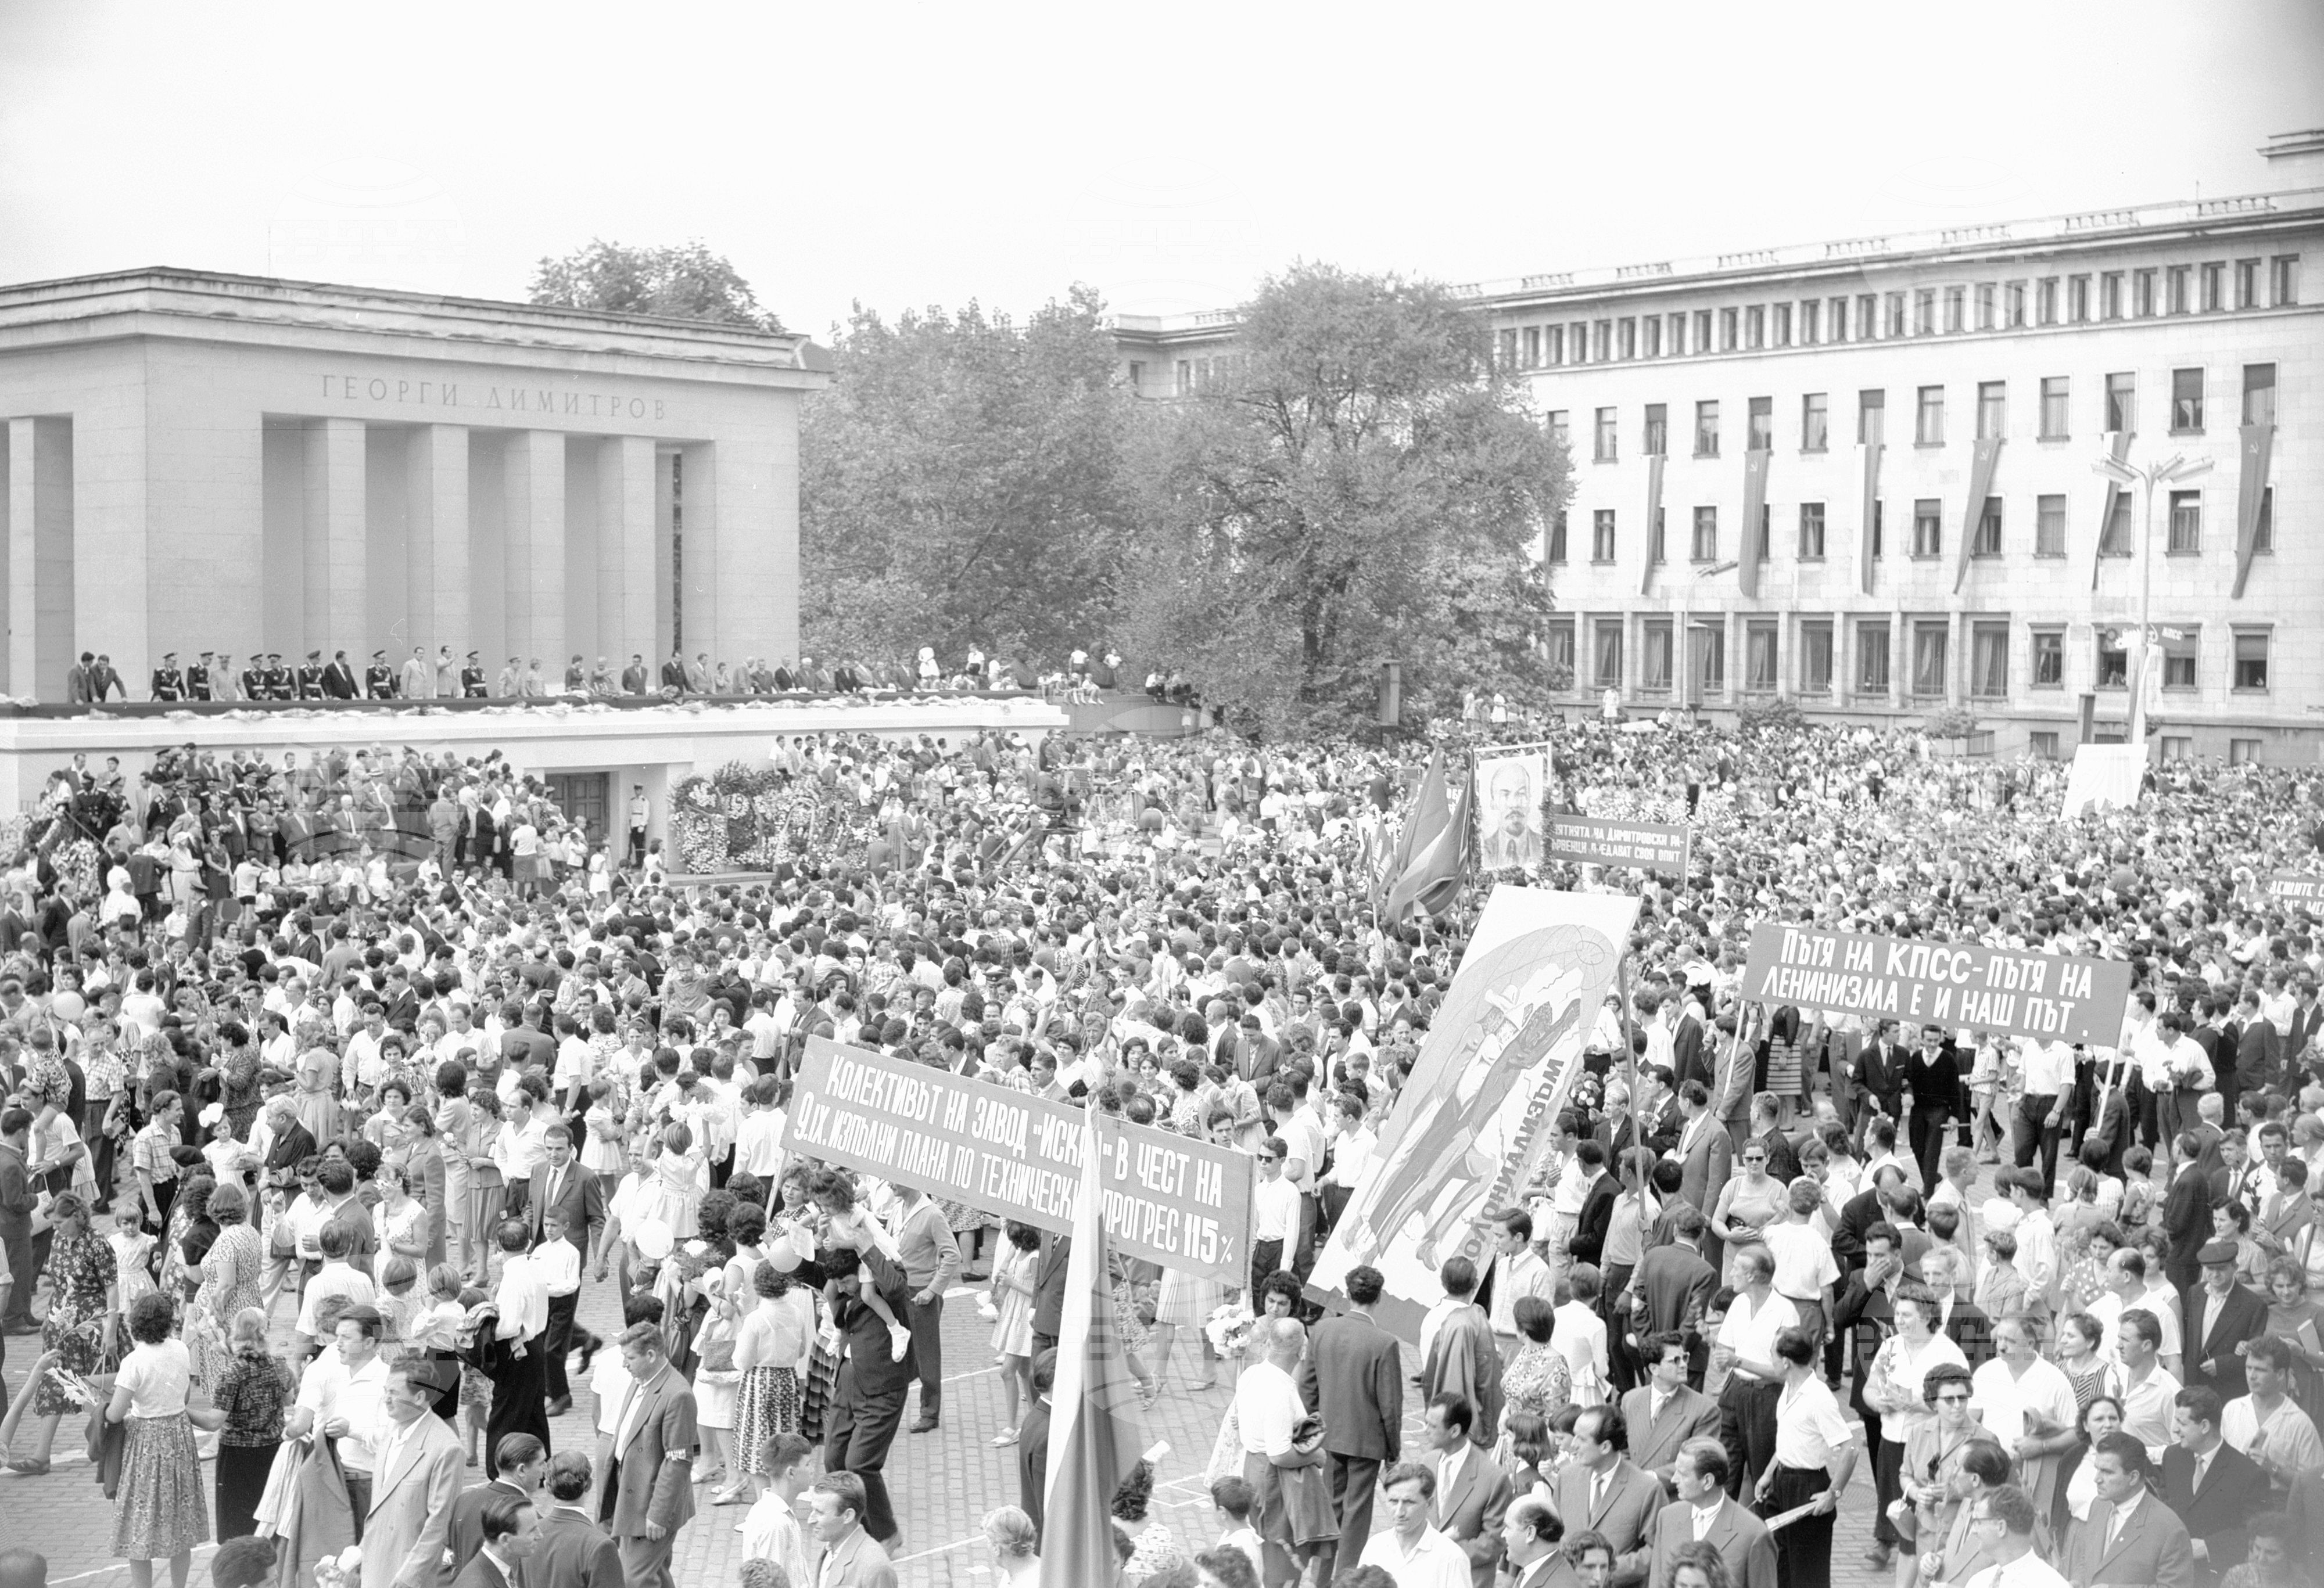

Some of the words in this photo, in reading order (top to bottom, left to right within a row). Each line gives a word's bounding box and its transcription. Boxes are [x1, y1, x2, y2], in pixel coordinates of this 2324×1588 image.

[322, 374, 458, 407] ГЕОРГИ
[486, 386, 665, 420] ДИМИТРОВ
[1634, 846, 1655, 861] СВОЯ
[1759, 966, 1898, 1012] ЛЕНИНИЗМА
[1910, 983, 1924, 1015] Е
[1933, 986, 1952, 1019] И
[1959, 990, 2015, 1027] НАШ
[1780, 929, 1836, 968] ПЪТЯ
[1844, 940, 1874, 972] НА
[2058, 963, 2092, 999] НА
[824, 1054, 944, 1125] КОЛЕКТИВЪТ
[942, 1089, 970, 1134] НА
[971, 1096, 1029, 1160] ЗАВОД
[1114, 1136, 1129, 1180] В
[1136, 1142, 1190, 1197] ЧЕСТ
[1194, 1158, 1222, 1208] НА
[1464, 1058, 1565, 1264] ОЛОНИАЛИЗЪМ
[827, 1109, 899, 1166] ИЗПЪЛНИ
[896, 1129, 950, 1182] ПЛАНА
[950, 1144, 975, 1189] ПО
[1103, 1188, 1179, 1252] ПРОГРЕС
